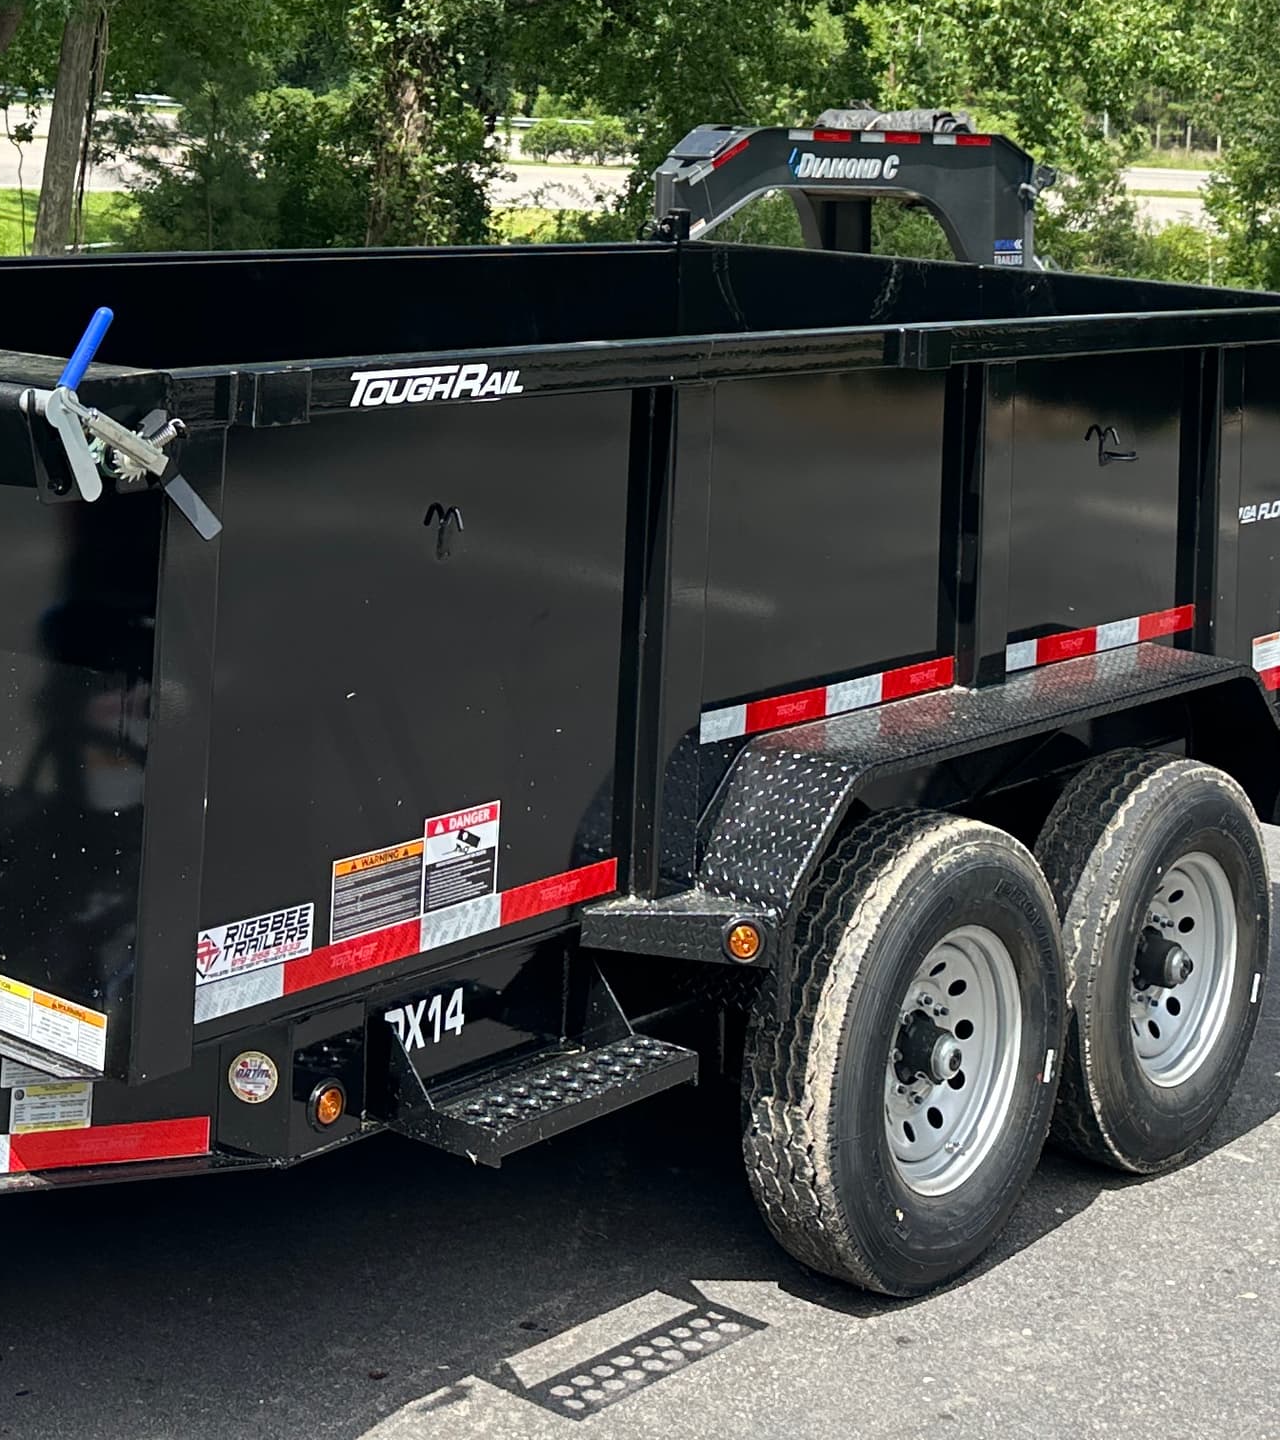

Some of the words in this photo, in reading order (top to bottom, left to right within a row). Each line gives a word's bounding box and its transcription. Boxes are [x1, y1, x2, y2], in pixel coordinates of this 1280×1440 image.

[797, 153, 882, 178] DIAMOND
[882, 154, 900, 179] C
[449, 808, 491, 830] DANGER
[361, 849, 400, 866] WARNING
[224, 906, 311, 944] RIGSBEE
[224, 924, 310, 961] TRAILERS
